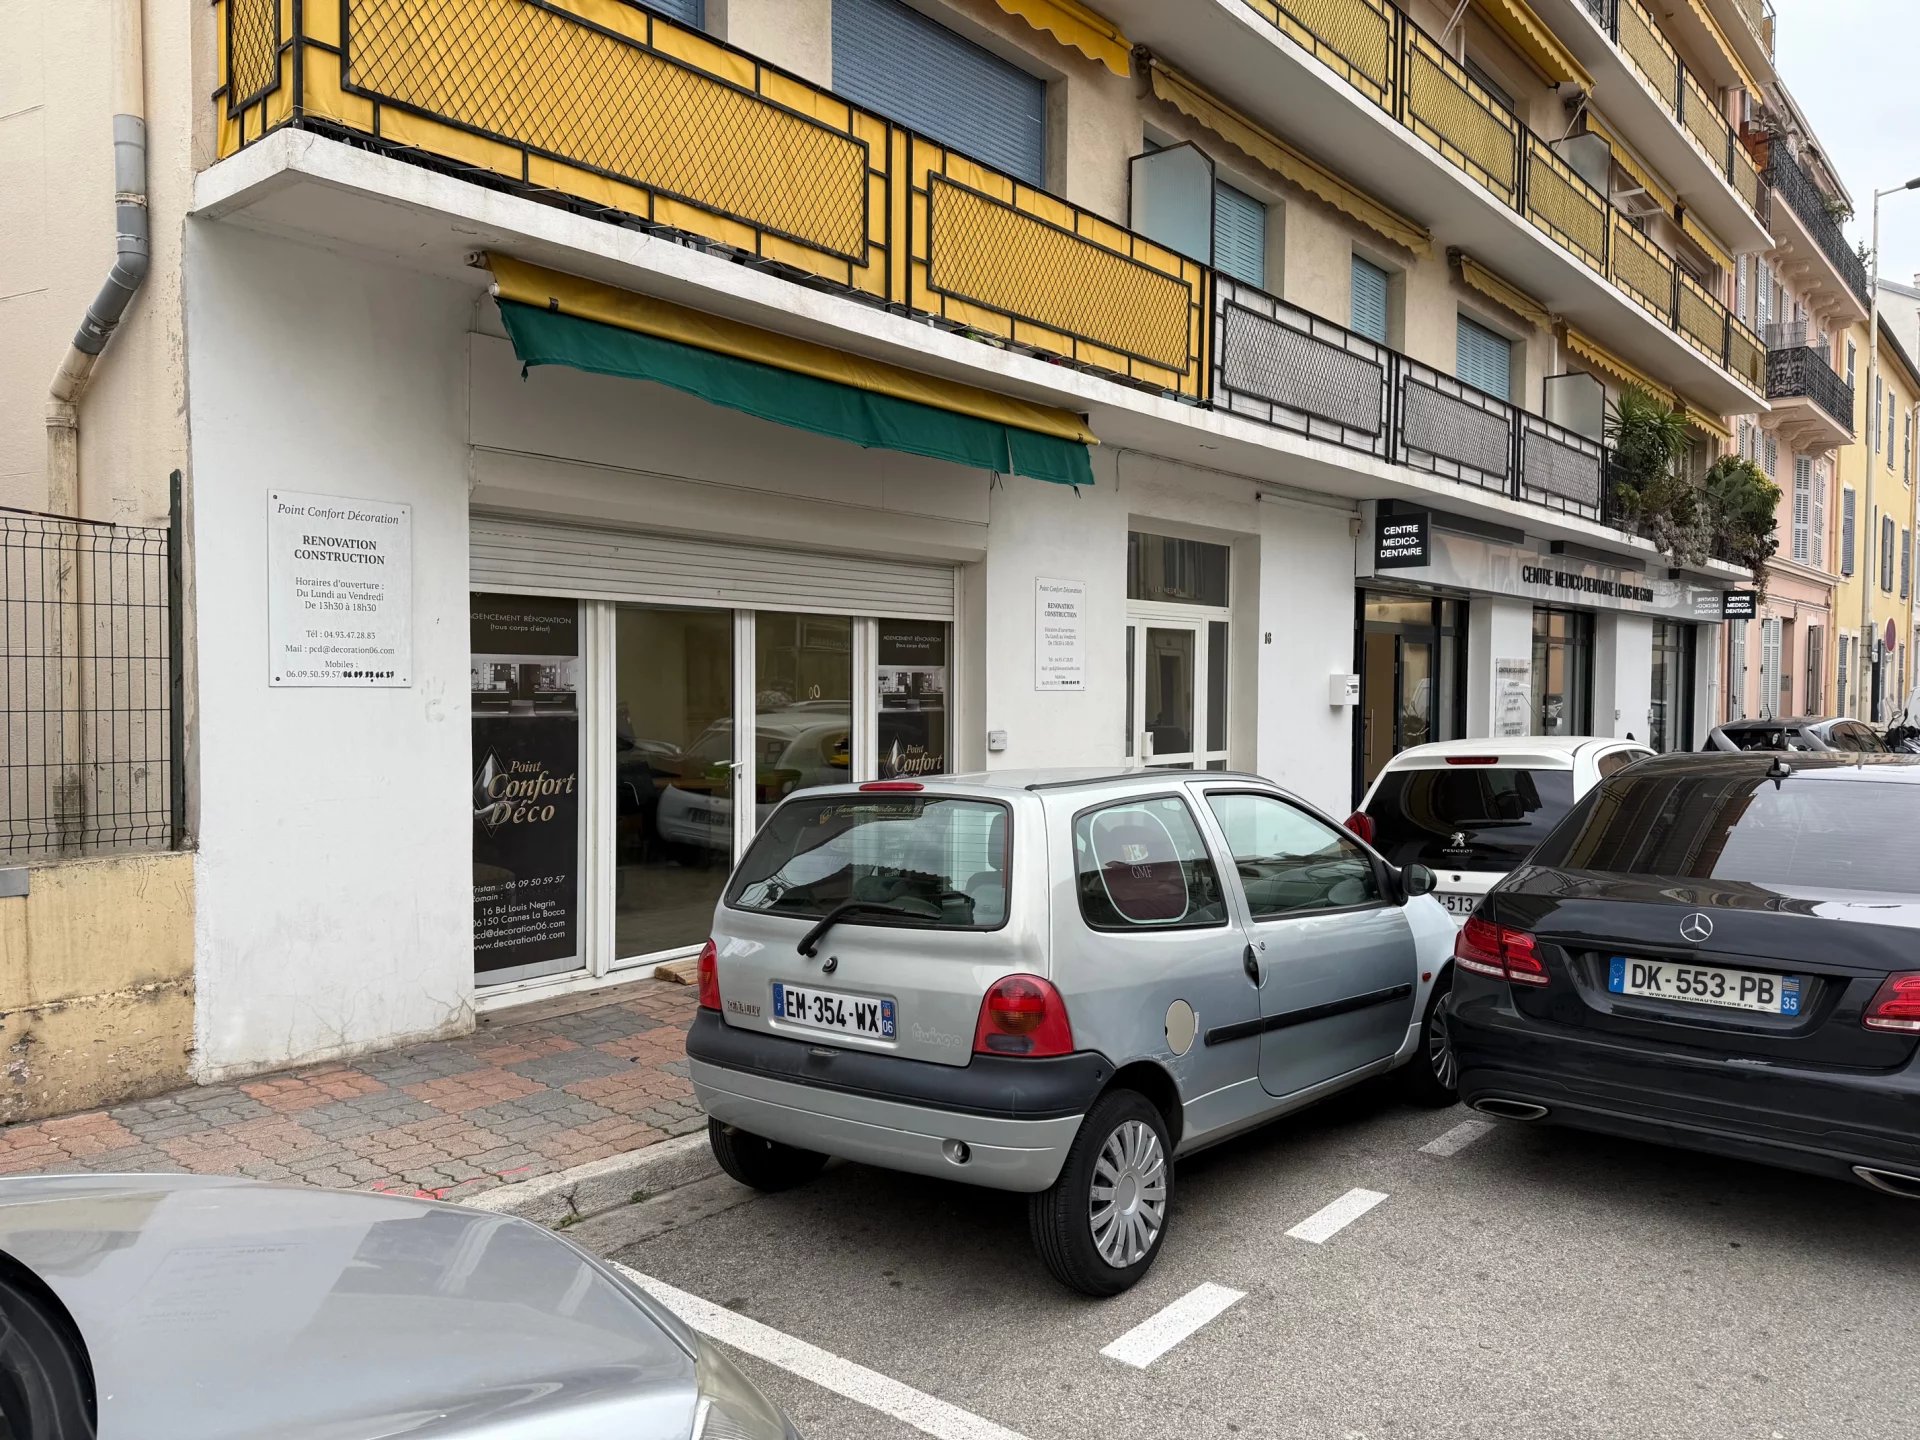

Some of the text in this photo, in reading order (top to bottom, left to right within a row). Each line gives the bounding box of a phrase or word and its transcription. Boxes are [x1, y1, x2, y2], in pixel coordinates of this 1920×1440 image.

[278, 503, 400, 525] Point Confort Décoration
[1384, 524, 1418, 535] CENTRE
[302, 534, 377, 550] RENOVATION
[1382, 536, 1420, 547] MEDICO-
[294, 548, 385, 565] CONSTRUCTION
[1380, 547, 1422, 558] DENTAIRE
[1522, 565, 1554, 586] CENTRE
[296, 576, 331, 587] Horaires
[333, 578, 380, 590] d'ouverture
[296, 588, 384, 601] Du Lundi au Vendredi
[304, 600, 376, 612] De 13h30 à 18h30
[1048, 602, 1074, 610] RENOVATION
[470, 612, 572, 624] GENCEMENT RÉNOVATION
[306, 630, 318, 638] Tél
[490, 624, 508, 632] (tous
[286, 644, 302, 653] Mail
[309, 644, 395, 655] pcd@decoration06.com
[906, 744, 924, 754] Point
[510, 760, 542, 773] Point
[895, 752, 942, 776] Confort
[488, 771, 576, 804] Confort
[488, 800, 555, 826] Déco
[1132, 865, 1152, 878] GMF
[506, 881, 516, 890] 06
[518, 880, 528, 888] 09
[530, 878, 541, 886] 50
[542, 876, 553, 884] 59
[554, 874, 566, 884] 57
[483, 900, 556, 916] 16 Bd Louis Negrin
[501, 914, 530, 924] Cannes
[532, 912, 540, 920] La
[542, 909, 566, 918] Bocca
[1614, 978, 1619, 986] F
[1631, 964, 1774, 1005] DK-553-PB
[1648, 992, 1754, 1009] WWW.PREMIUMAUTOSTORE.FR
[1783, 997, 1797, 1010] 35
[786, 990, 878, 1032] EM-354-WX
[882, 1020, 894, 1034] 06
